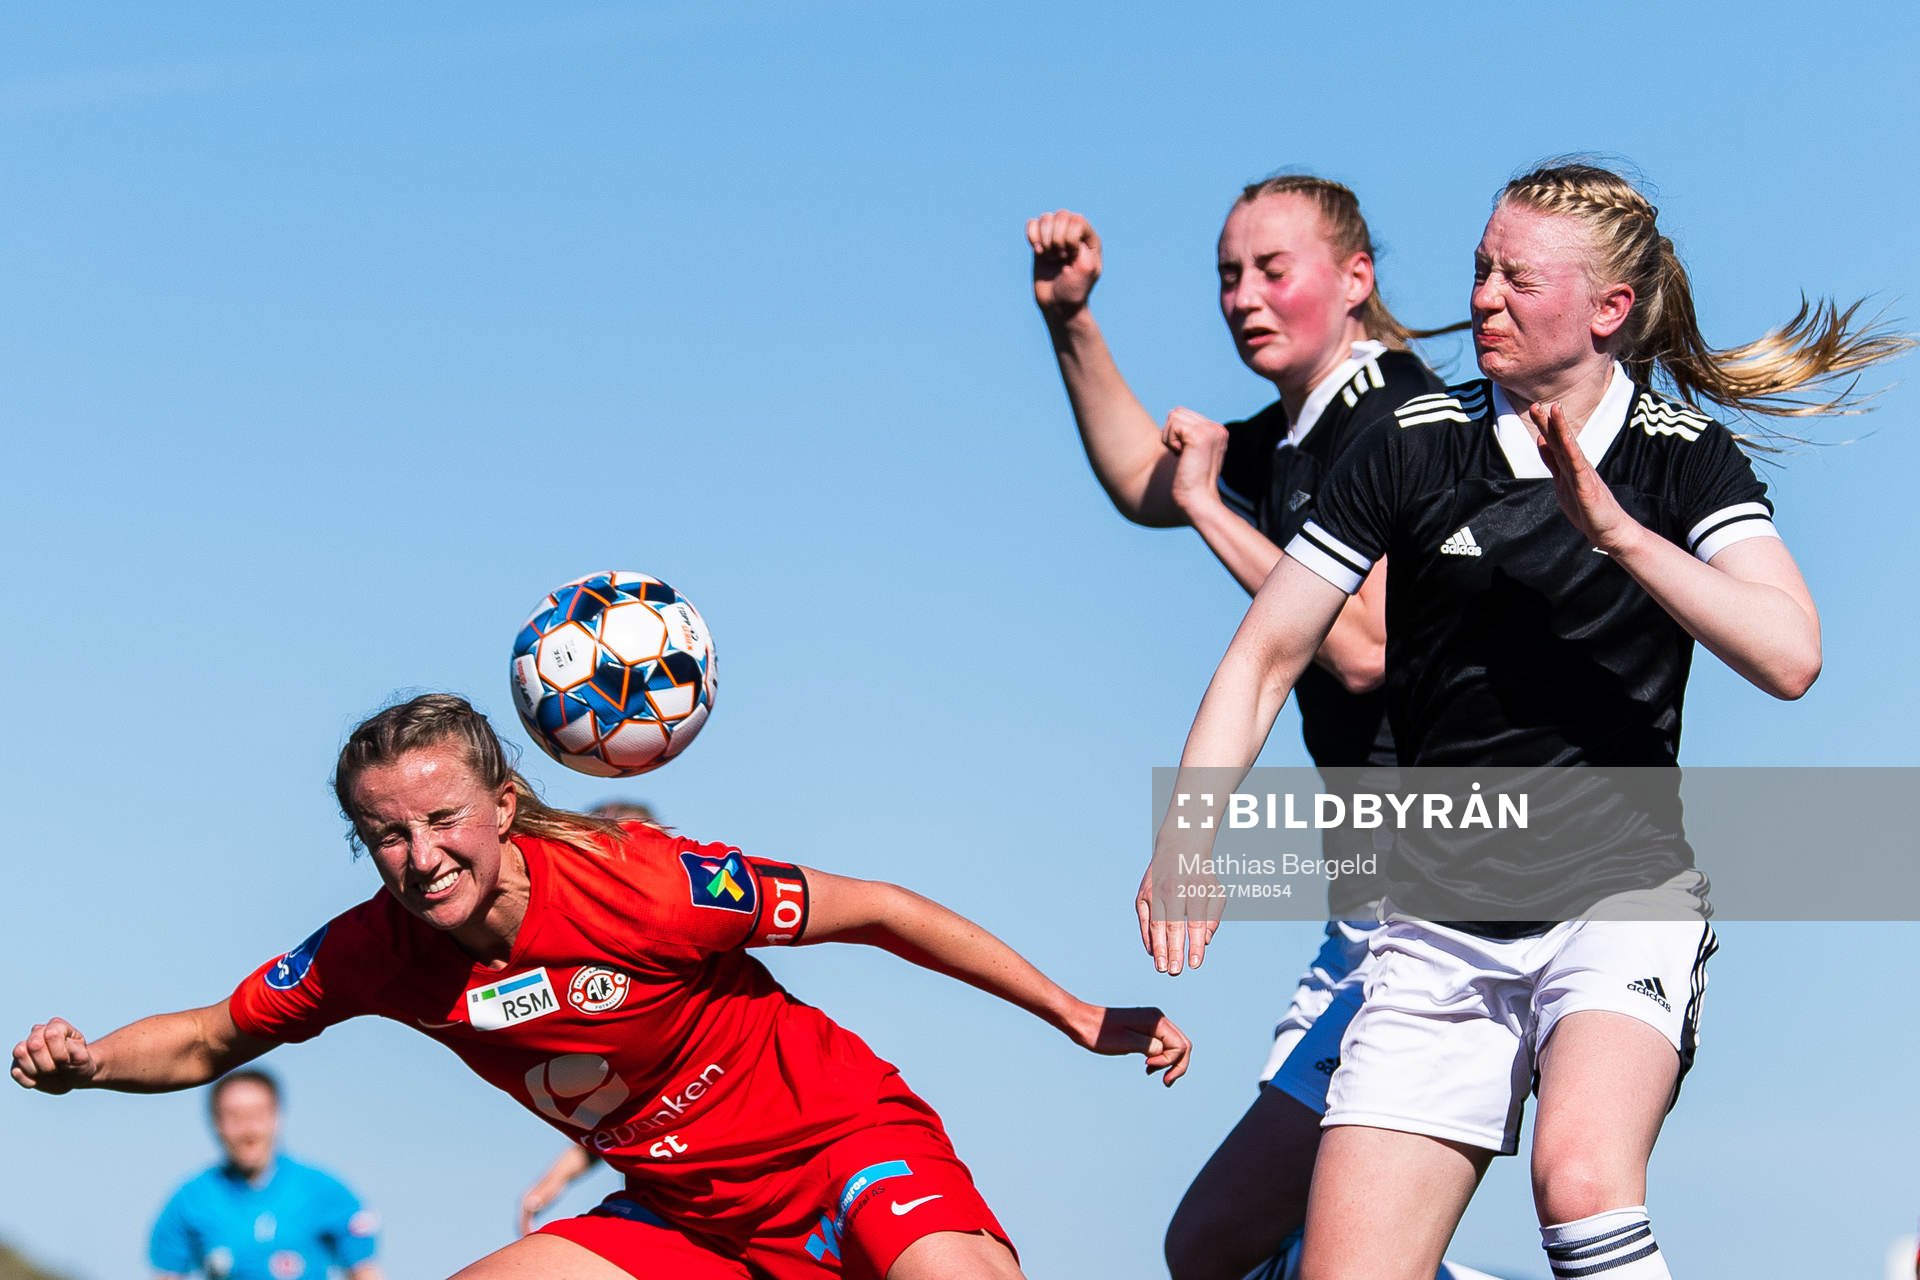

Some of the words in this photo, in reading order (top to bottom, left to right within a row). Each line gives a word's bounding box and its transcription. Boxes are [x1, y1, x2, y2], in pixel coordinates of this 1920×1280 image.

[1440, 544, 1482, 556] adidas
[502, 988, 554, 1021] RSM
[1627, 983, 1671, 1013] adidas
